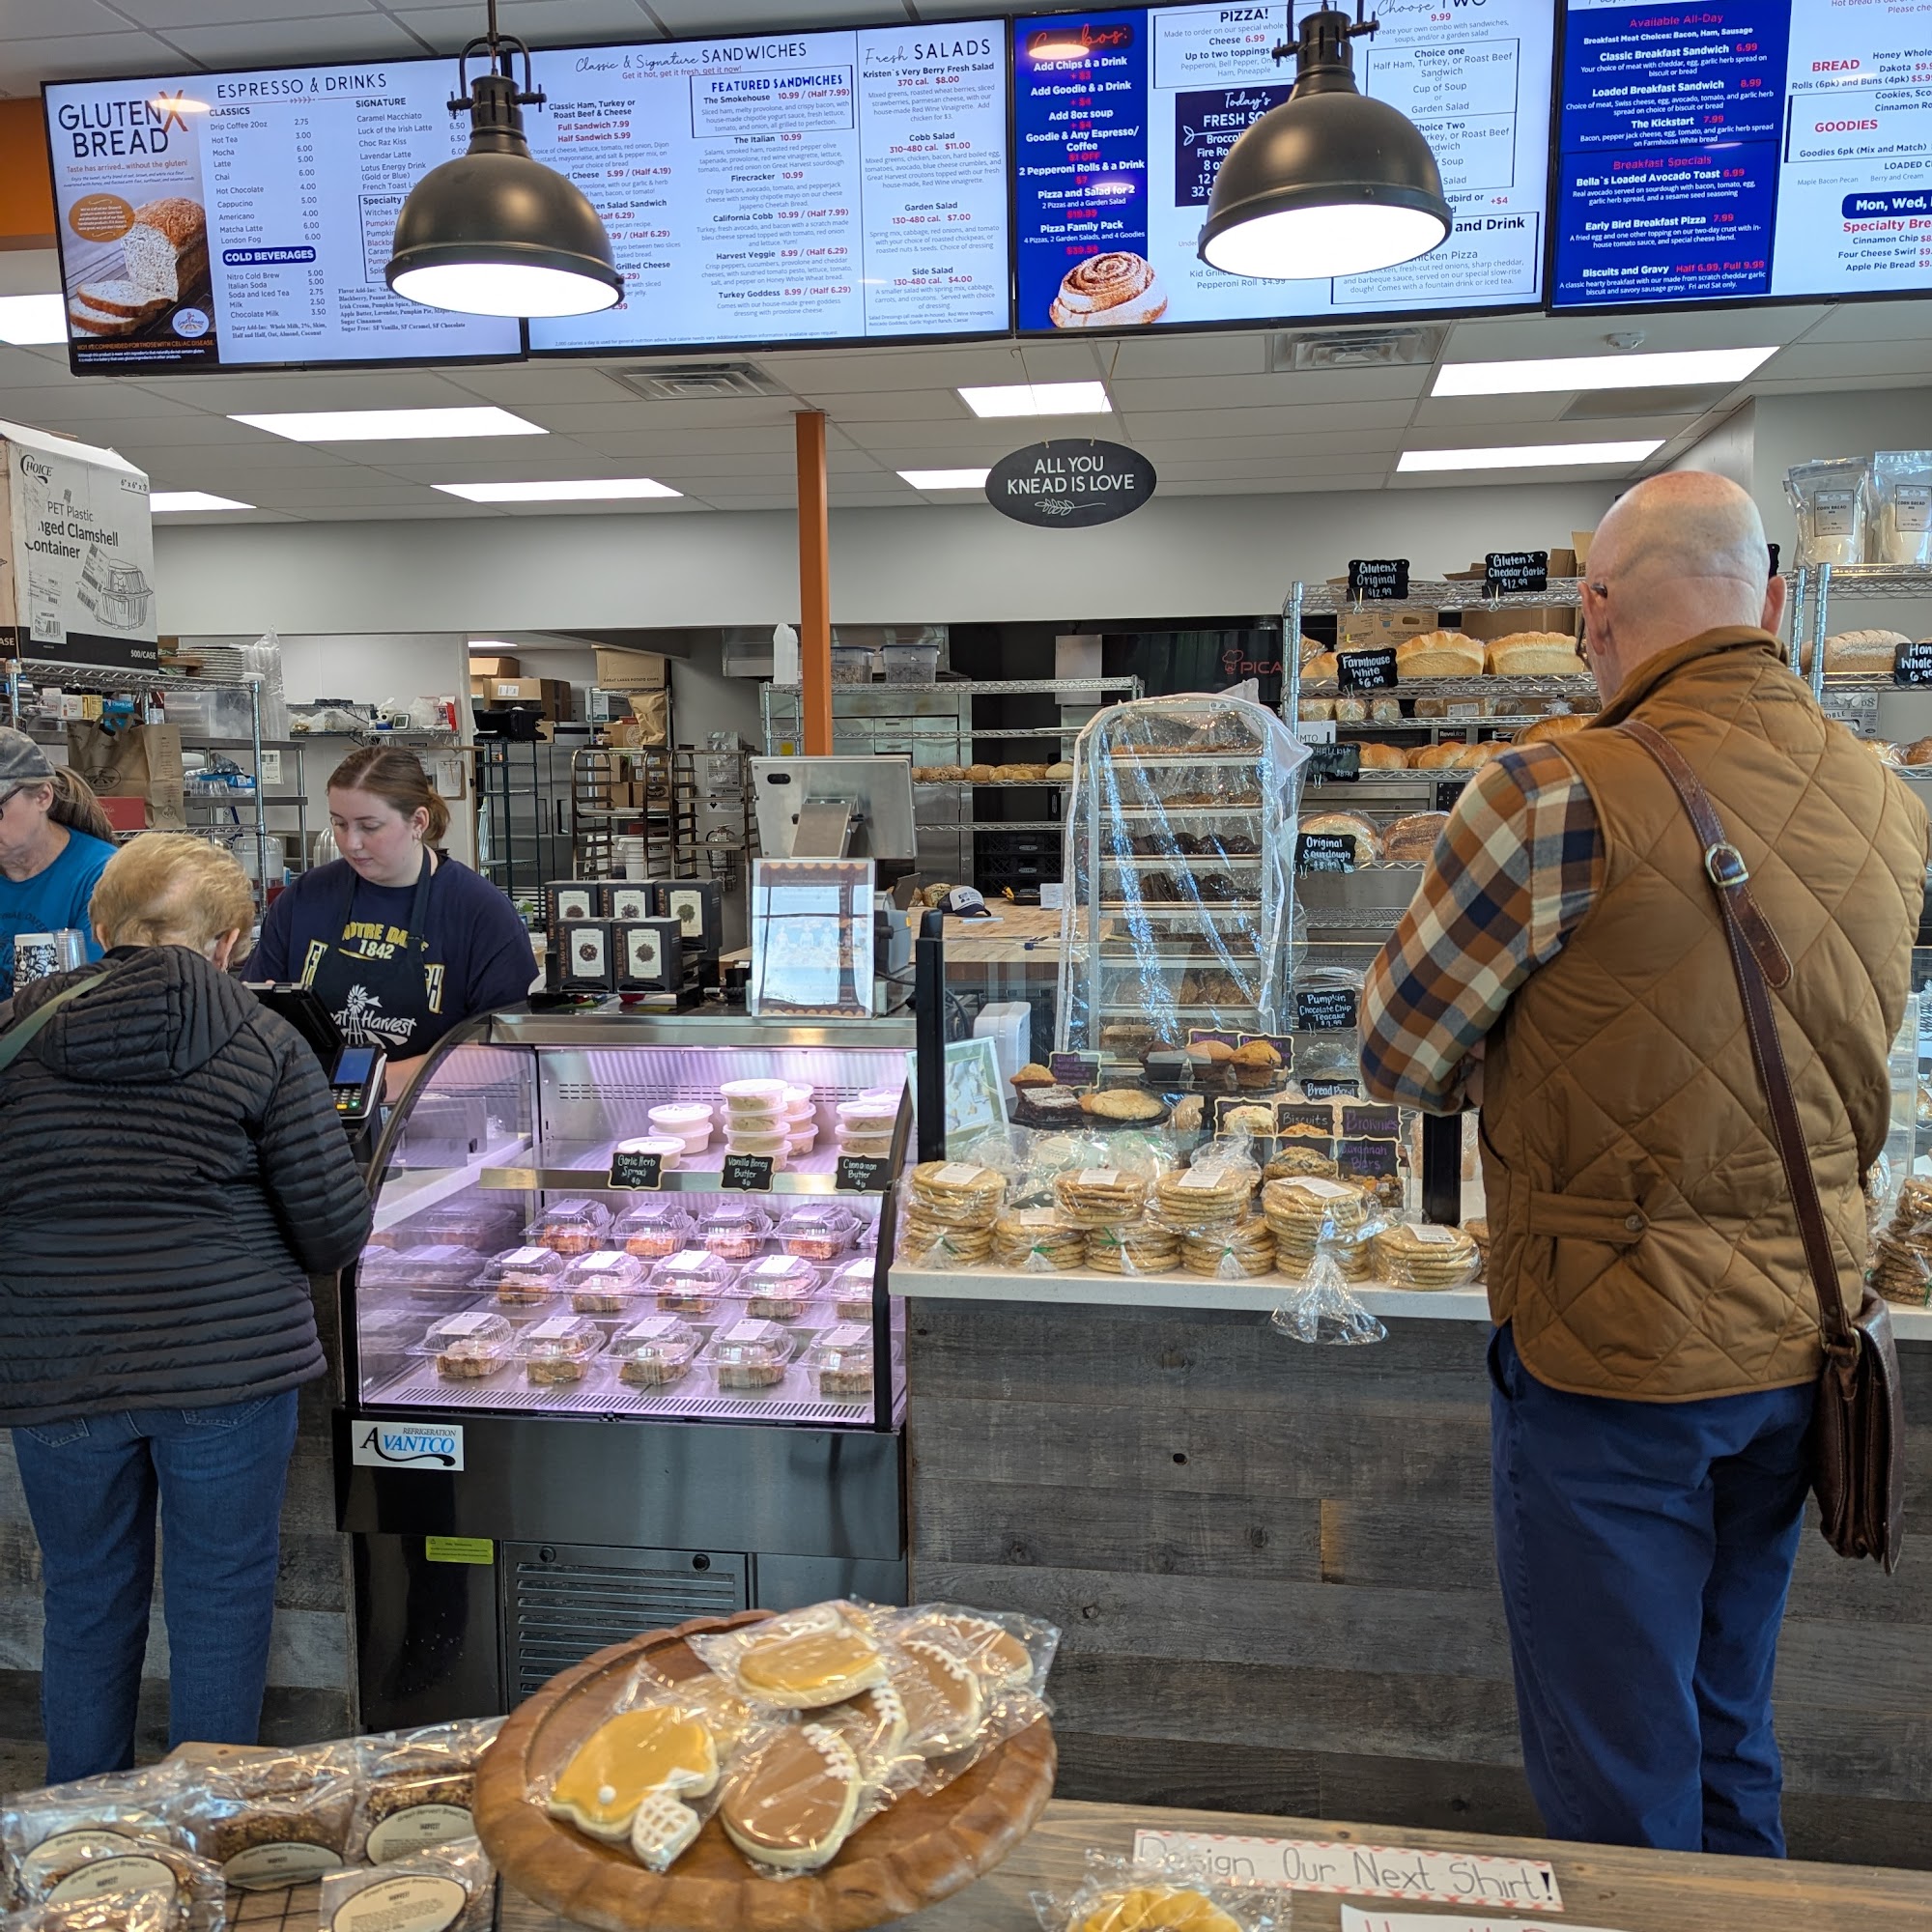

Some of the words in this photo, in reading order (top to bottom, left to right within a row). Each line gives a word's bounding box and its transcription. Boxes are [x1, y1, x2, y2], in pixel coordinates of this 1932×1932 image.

[1220, 9, 1268, 22] PIZZA!
[1431, 13, 1451, 22] 9.99
[1630, 15, 1680, 28] Available
[1684, 14, 1723, 25] All-Day
[1208, 36, 1240, 46] Cheese
[1245, 34, 1264, 43] 6.99
[575, 55, 618, 73] Classic
[636, 51, 698, 71] Signature
[701, 43, 807, 64] SANDWICHES
[866, 45, 908, 65] Fresh
[915, 39, 991, 60] SALADS
[1185, 52, 1198, 62] Up
[1211, 49, 1228, 59] two
[1231, 47, 1269, 58] toppings
[1414, 48, 1445, 58] Choice
[1448, 47, 1465, 56] one
[1600, 51, 1633, 62] Classic
[1634, 48, 1681, 60] Breakfast
[1683, 44, 1729, 56] Sandwich
[1873, 50, 1901, 61] Honey
[901, 67, 921, 77] Very
[923, 65, 945, 76] Berry
[948, 64, 969, 74] Fresh
[972, 62, 994, 71] Salad
[1034, 62, 1051, 71] Add
[1053, 59, 1082, 71] Chips
[1085, 59, 1092, 68] &
[1101, 56, 1127, 67] Drink
[1812, 60, 1860, 71] BREAD
[1880, 64, 1911, 73] Dakota
[1421, 67, 1463, 77] Sandwich
[217, 78, 303, 99] ESPRESSO
[310, 78, 319, 94] &
[326, 73, 386, 91] DRINKS
[711, 78, 771, 94] FEATURED
[773, 74, 843, 90] SANDWICHES
[356, 98, 406, 108] SIGNATURE
[721, 94, 770, 104] Smokehouse
[209, 106, 250, 117] CLASSICS
[1411, 103, 1442, 114] Garden
[1445, 101, 1469, 111] Salad
[387, 112, 422, 121] Macchiato
[1204, 114, 1245, 128] FRESH
[1814, 120, 1878, 133] GOODIES
[72, 128, 168, 157] BREAD
[909, 133, 930, 142] Cobb
[933, 131, 955, 140] Salad
[1885, 160, 1922, 170] LOADED
[731, 173, 775, 183] Firecracker
[363, 196, 402, 207] Specialty
[904, 202, 933, 212] Garden
[935, 201, 957, 210] Salad
[1491, 196, 1508, 205] +$4
[1856, 199, 1888, 213] Mon,
[1892, 196, 1926, 211] Wed,
[1040, 223, 1065, 234] Pizza
[1067, 221, 1098, 234] Family
[1100, 219, 1123, 230] Pack
[1455, 218, 1482, 233] and
[1487, 216, 1525, 231] Drink
[1843, 220, 1905, 234] Specialty
[225, 252, 252, 263] COLD
[255, 249, 314, 261] BEVERAGES
[1582, 267, 1619, 278] Biscuits
[1621, 265, 1640, 275] and
[1642, 265, 1669, 276] Gravy
[1035, 458, 1065, 474] ALL
[1067, 456, 1104, 472] YOU
[1008, 477, 1067, 495] KNEAD
[1072, 476, 1085, 492] IS
[1091, 474, 1135, 492] LOVE
[48, 500, 64, 515] PET
[68, 506, 94, 522] Plastic
[68, 524, 118, 547] Clamshell
[1489, 567, 1520, 577] Cheddar
[1522, 567, 1546, 576] Garlic
[1356, 575, 1396, 587] Original
[1501, 579, 1528, 589] $12.99
[1368, 587, 1392, 597] $12.99
[130, 649, 156, 660] 500/CASE
[1910, 644, 1932, 656] Hon
[1343, 655, 1391, 669] Farmhouse
[1352, 667, 1379, 678] White
[1306, 837, 1343, 850] Original
[359, 939, 395, 959] 1842
[1307, 994, 1346, 1005] Pumpkin
[1299, 1006, 1334, 1016] Chocolate
[361, 1009, 417, 1037] Harvest
[1307, 1083, 1333, 1095] Bread
[1283, 1113, 1328, 1125] Biscuits
[639, 1156, 656, 1167] Herb
[727, 1157, 749, 1170] Vanilla
[843, 1160, 877, 1171] Cinnamon
[734, 1168, 757, 1179] Butter
[847, 1170, 870, 1179] Butter
[403, 1427, 456, 1436] REFRIGERATION
[1283, 1846, 1337, 1884] Our
[1353, 1850, 1436, 1893] Next
[1448, 1861, 1554, 1903] Shirt!
